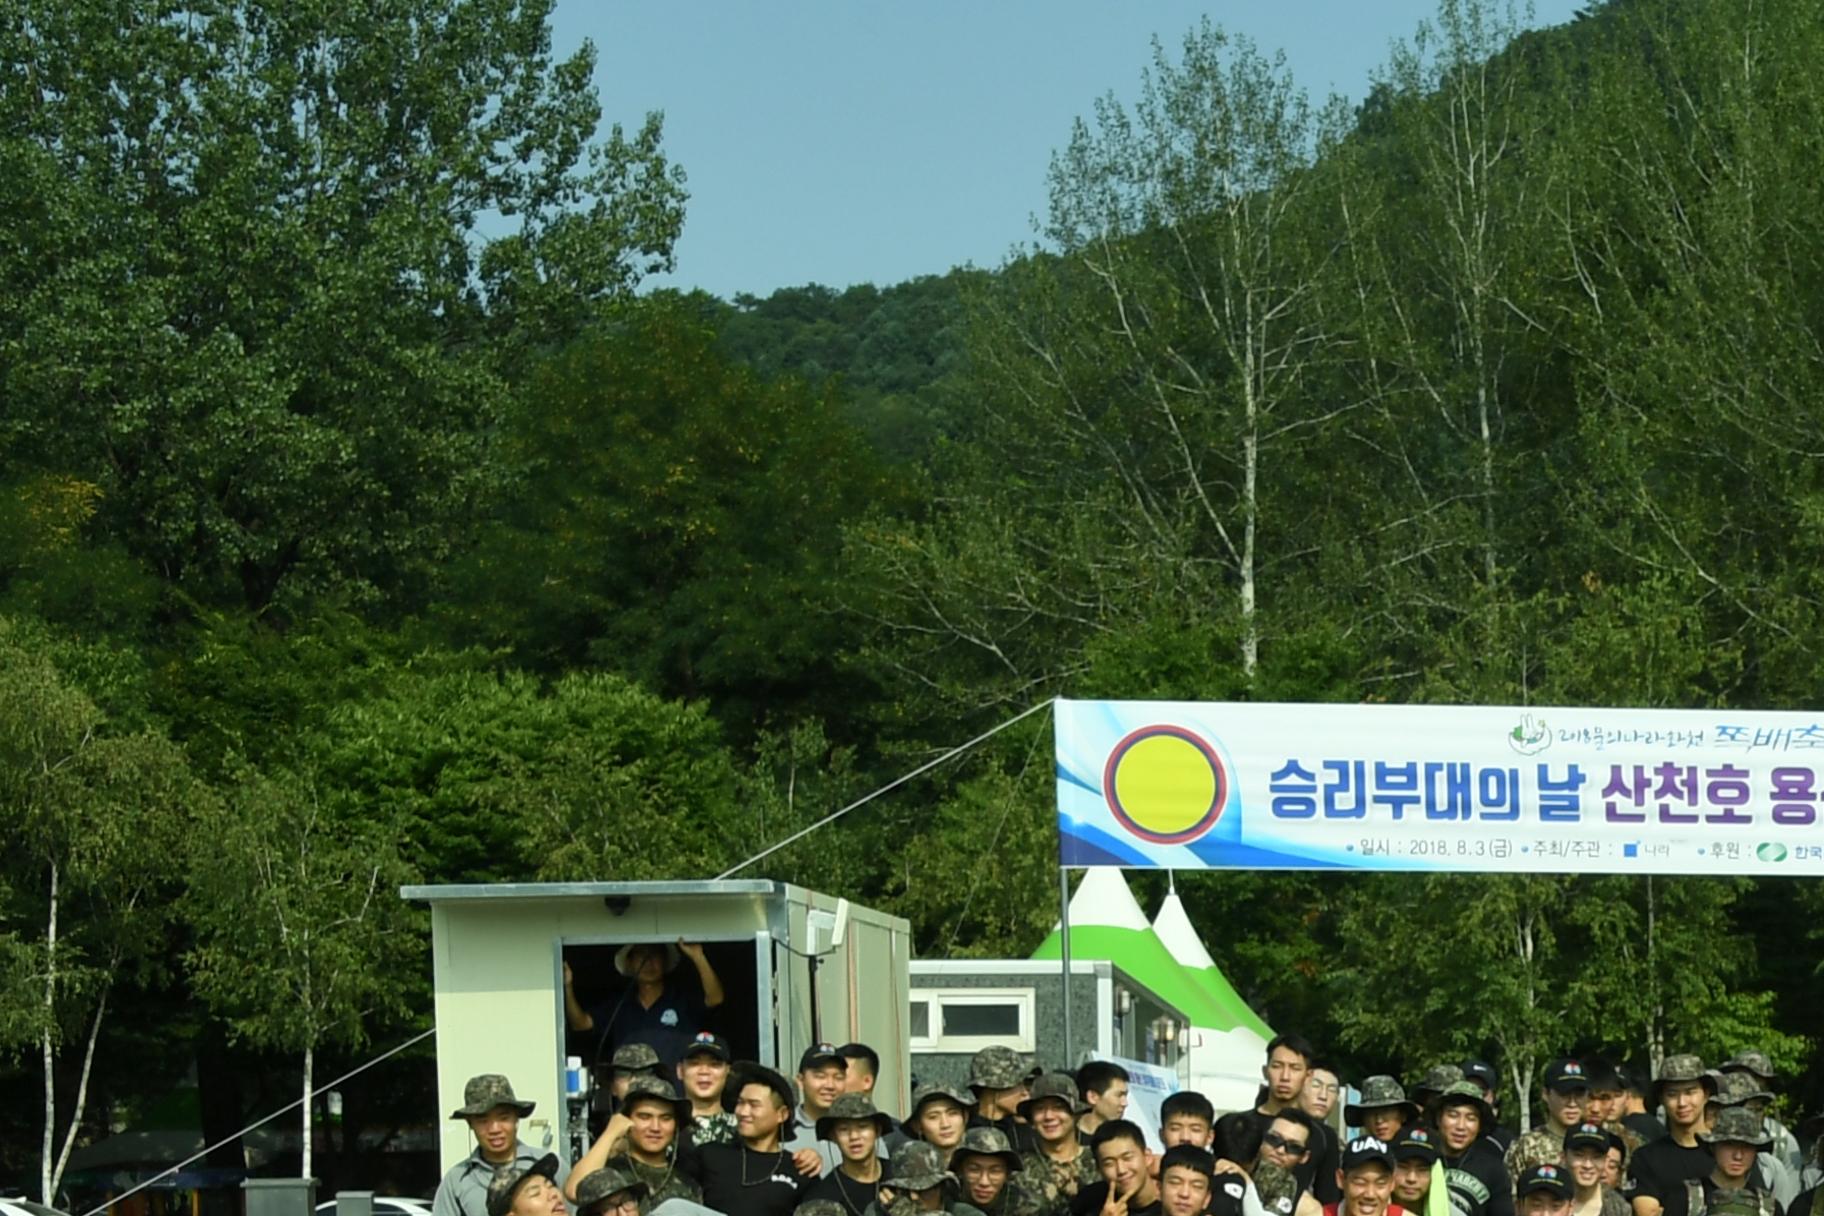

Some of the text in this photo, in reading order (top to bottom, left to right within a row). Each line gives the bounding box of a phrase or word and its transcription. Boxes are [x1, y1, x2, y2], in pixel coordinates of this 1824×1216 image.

[1268, 758, 1521, 821] 승리부대의
[1537, 762, 1587, 823] 날
[1601, 762, 1753, 825] 산천호
[1360, 838, 1390, 856] 일시
[1532, 838, 1601, 858] 주최/주관
[1710, 842, 1740, 860] 후원
